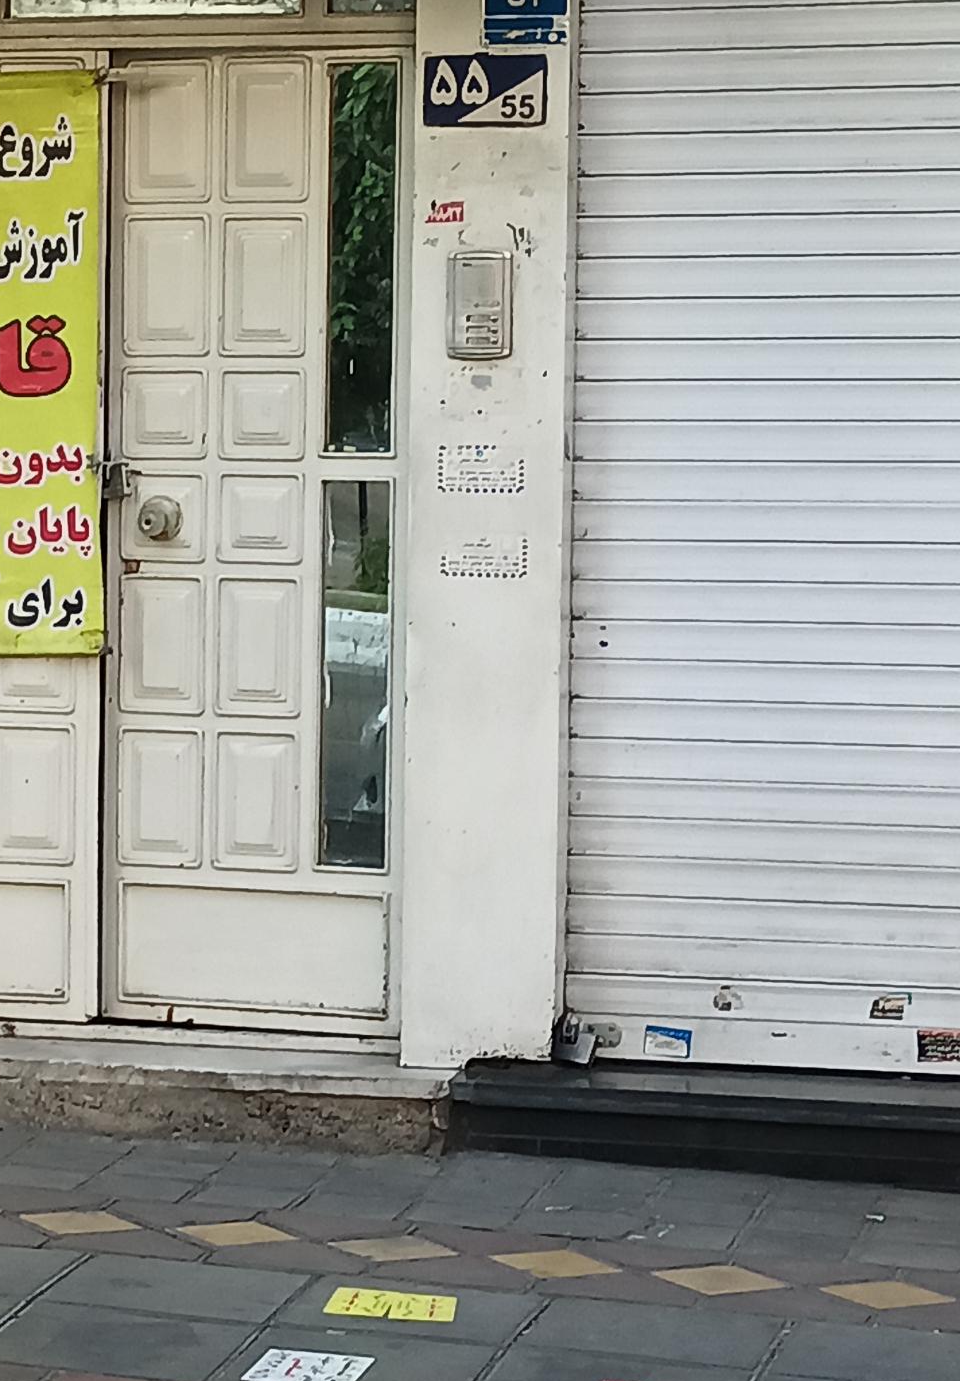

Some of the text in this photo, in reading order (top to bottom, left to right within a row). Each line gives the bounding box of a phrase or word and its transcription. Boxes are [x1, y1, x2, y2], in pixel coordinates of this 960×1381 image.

[430, 58, 490, 106] ۵۵
[500, 94, 536, 119] 55
[7, 508, 91, 556] پایان
[7, 579, 85, 628] برای
